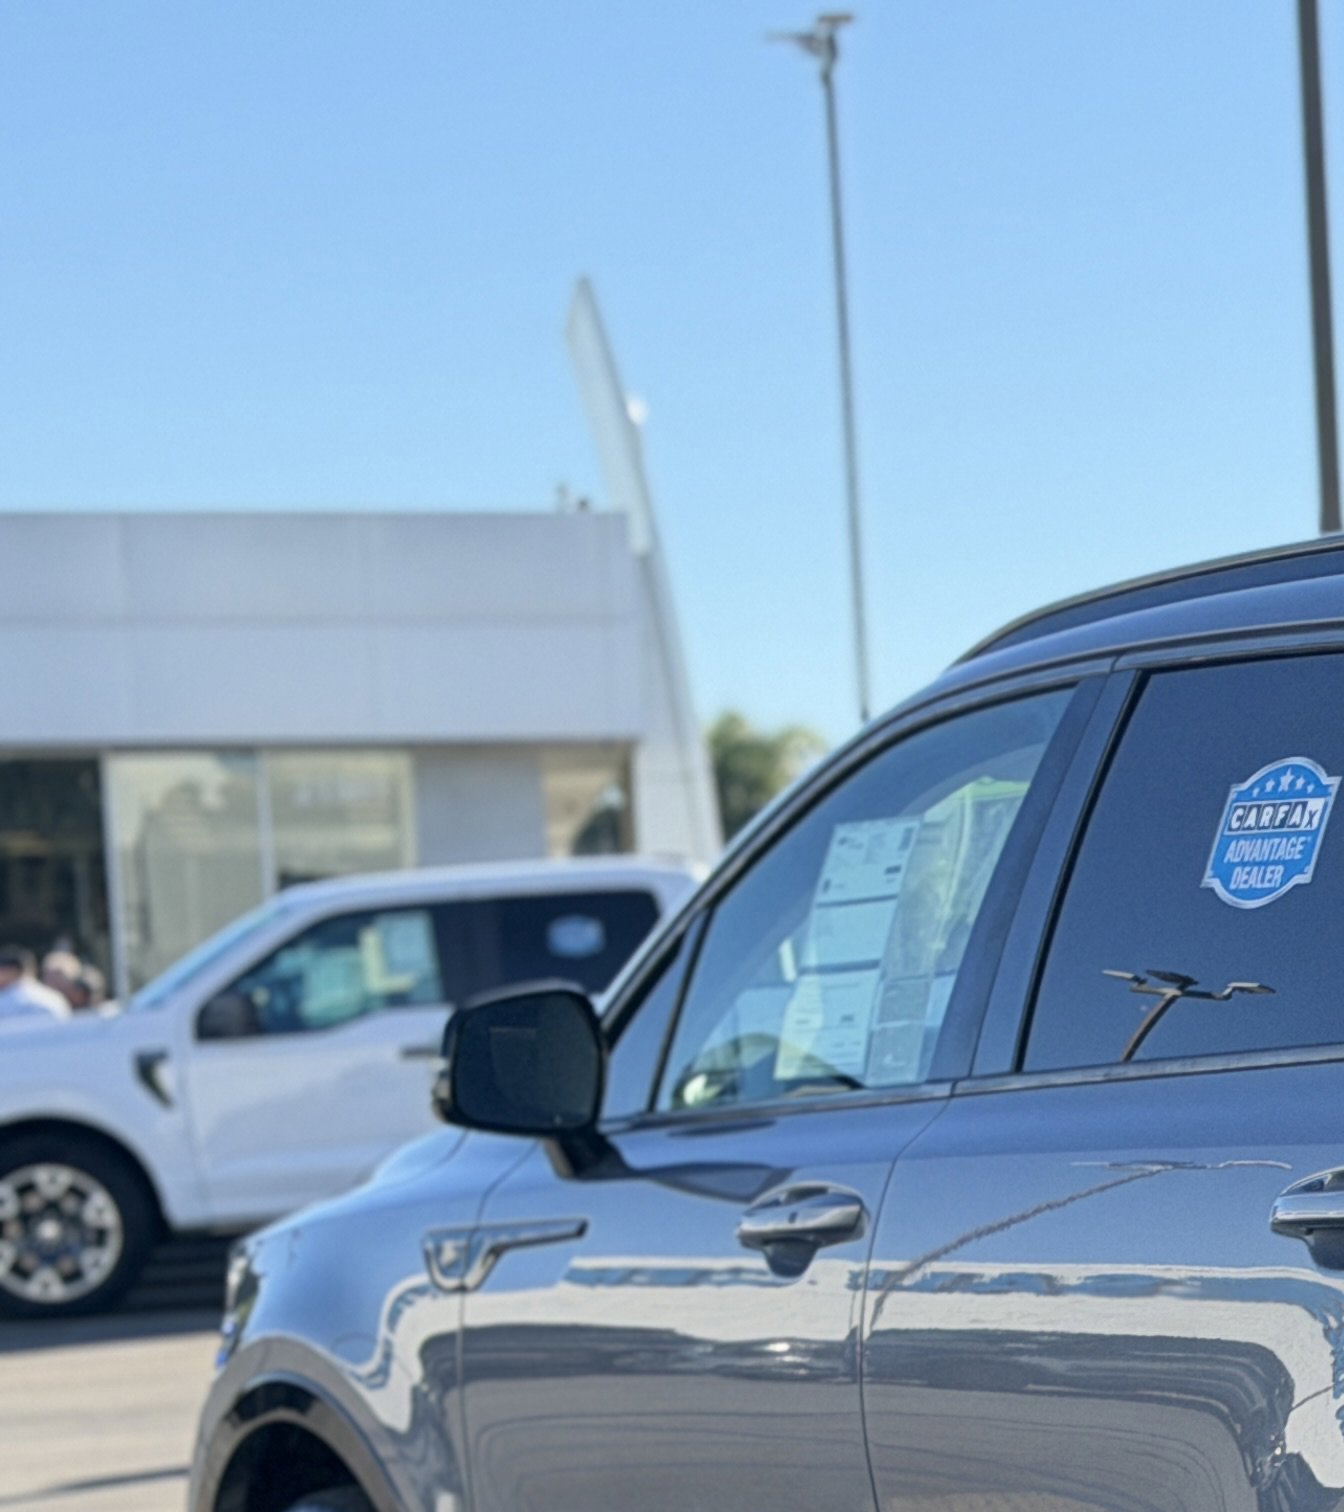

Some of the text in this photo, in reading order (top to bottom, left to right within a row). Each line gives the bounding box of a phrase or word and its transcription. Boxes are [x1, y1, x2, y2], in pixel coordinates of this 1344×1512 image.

[1231, 803, 1318, 829] CARFAX
[1224, 837, 1305, 863] ADVANTAGE
[1230, 865, 1284, 889] DEALER
